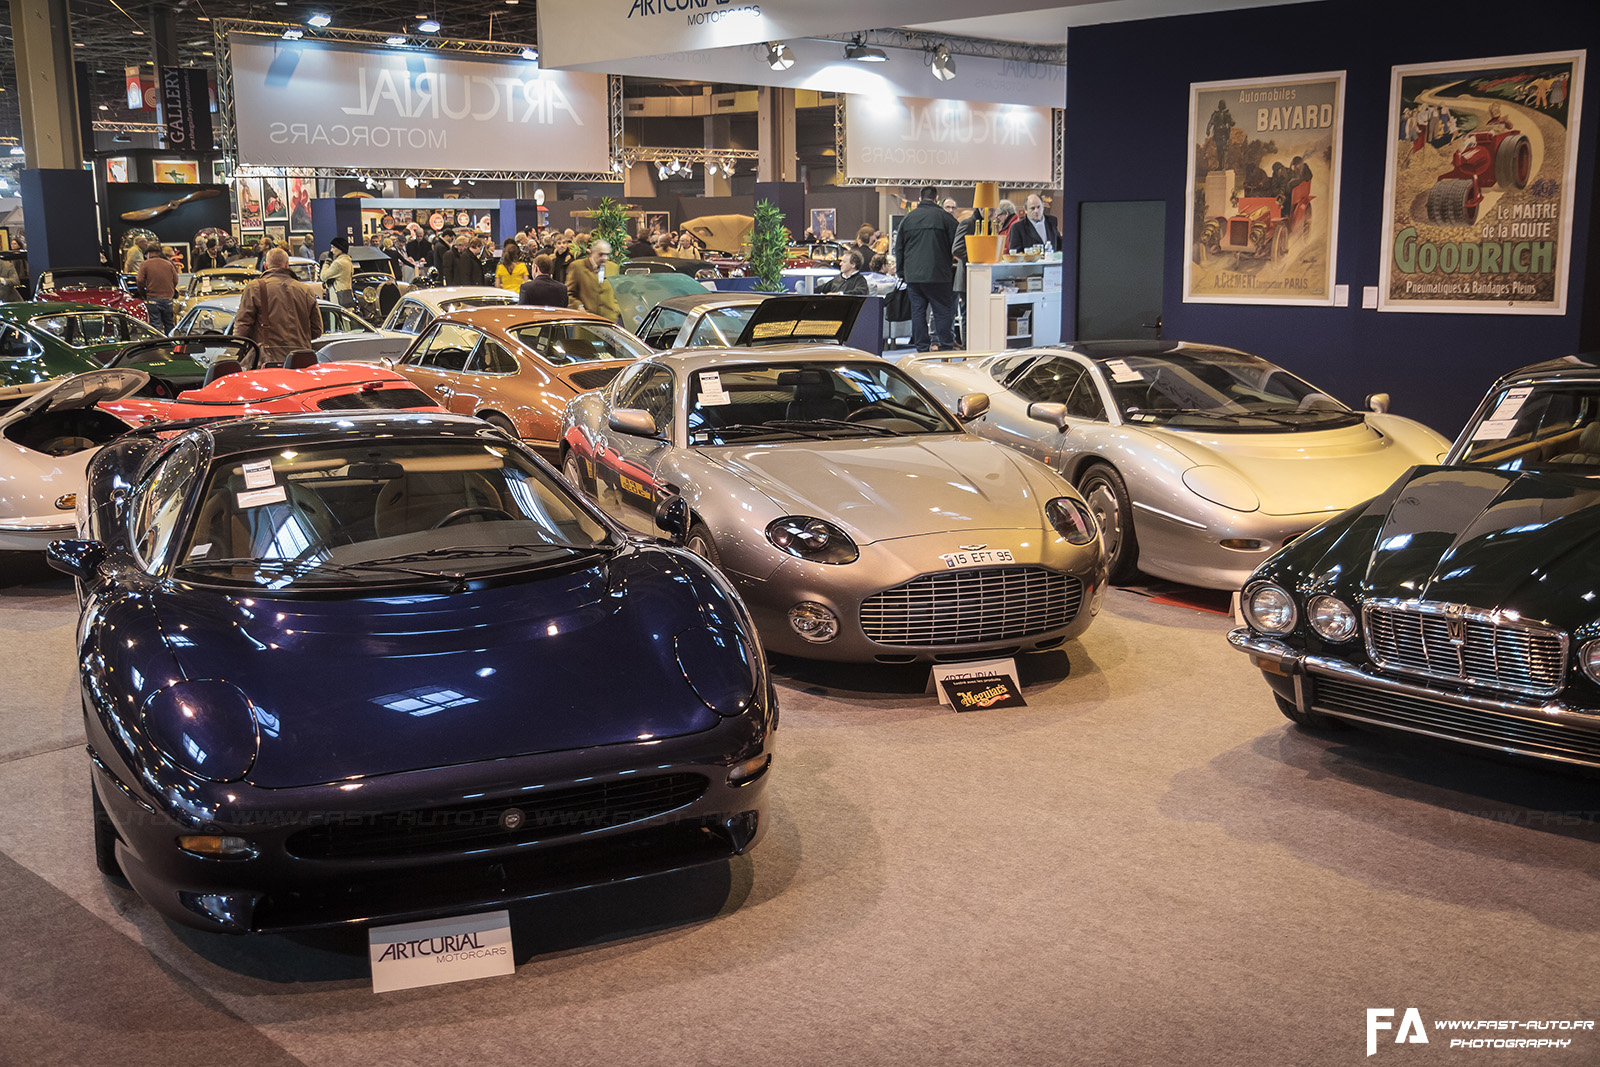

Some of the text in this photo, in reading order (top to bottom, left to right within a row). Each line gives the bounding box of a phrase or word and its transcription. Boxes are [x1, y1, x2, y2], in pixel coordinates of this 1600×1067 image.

[1239, 88, 1297, 103] Automobiles
[164, 68, 185, 143] GALLERY
[1256, 103, 1333, 132] BAYARD
[1497, 203, 1558, 220] Le MAITRE
[1482, 222, 1550, 238] de la ROUTE
[1394, 226, 1553, 274] GOODRICH
[1284, 278, 1309, 289] PARIS
[1405, 280, 1462, 295] Pneumatiques
[1472, 281, 1510, 297] Bandages
[1512, 281, 1537, 294] Pleins
[954, 551, 1013, 565] 15 EFT 95
[436, 947, 507, 963] MOTORCARS
